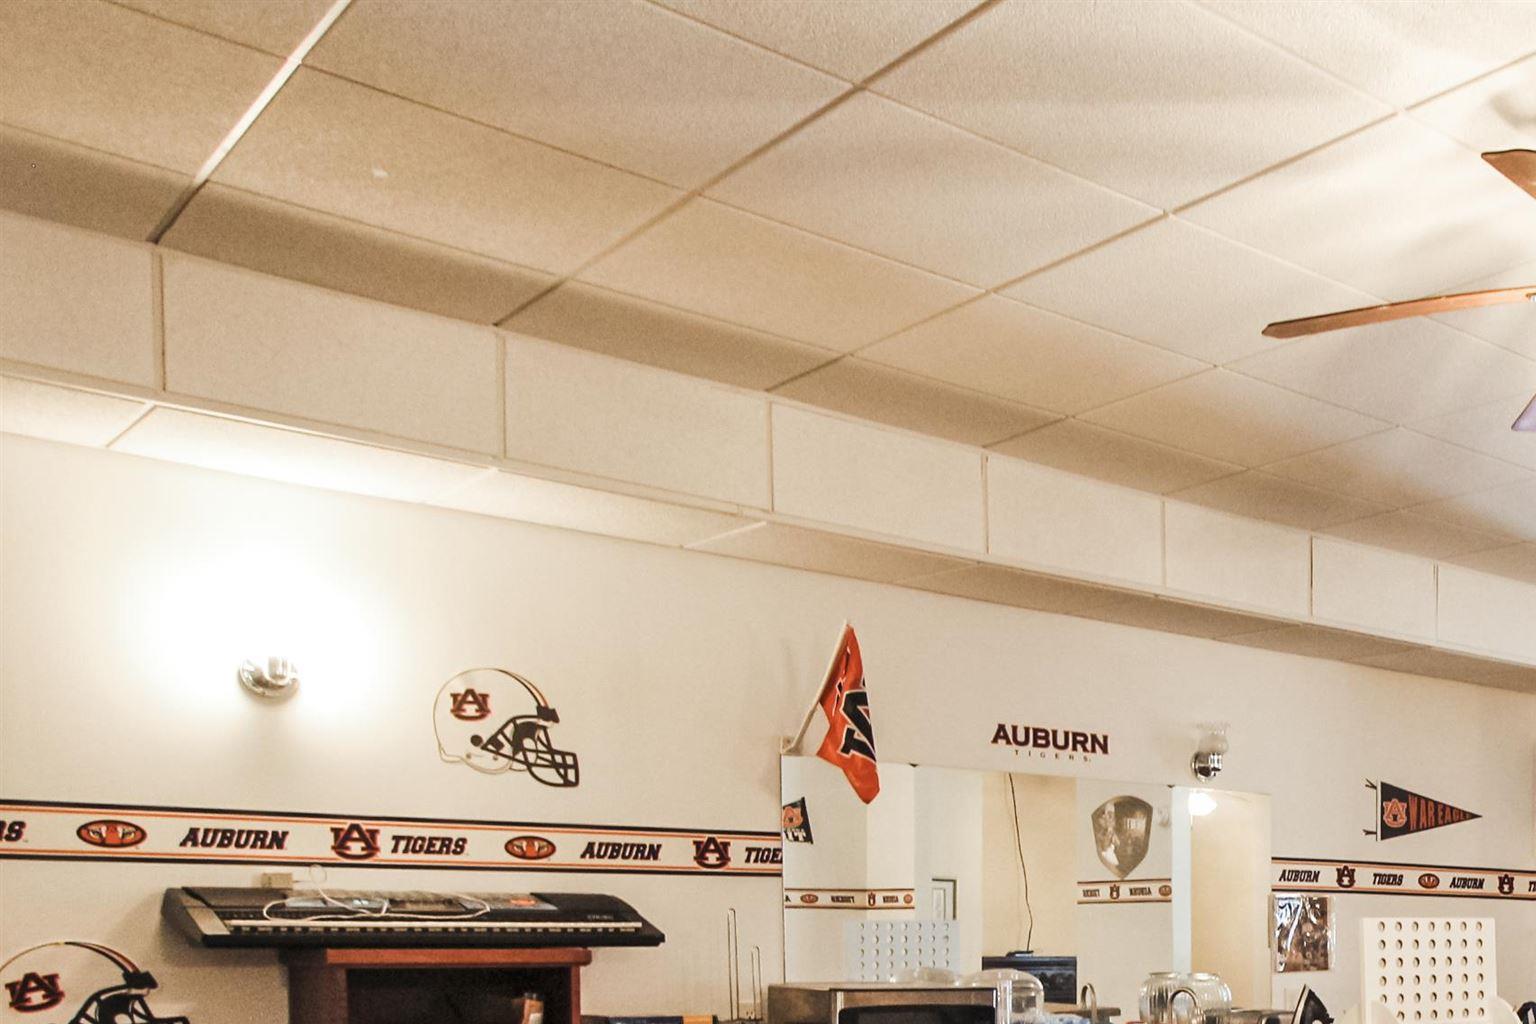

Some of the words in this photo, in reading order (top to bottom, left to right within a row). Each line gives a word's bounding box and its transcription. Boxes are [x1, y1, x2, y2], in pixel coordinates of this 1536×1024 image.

[991, 723, 1108, 754] AUBURN
[1408, 794, 1435, 831] WAR
[179, 827, 289, 850] AUBURN
[391, 835, 468, 855] TIGERS
[580, 842, 662, 861] AUBURN
[744, 847, 783, 864] TIGE
[1279, 869, 1320, 883] AUBURN
[1372, 873, 1404, 886] TIGERS
[1449, 877, 1485, 889] AUBURN
